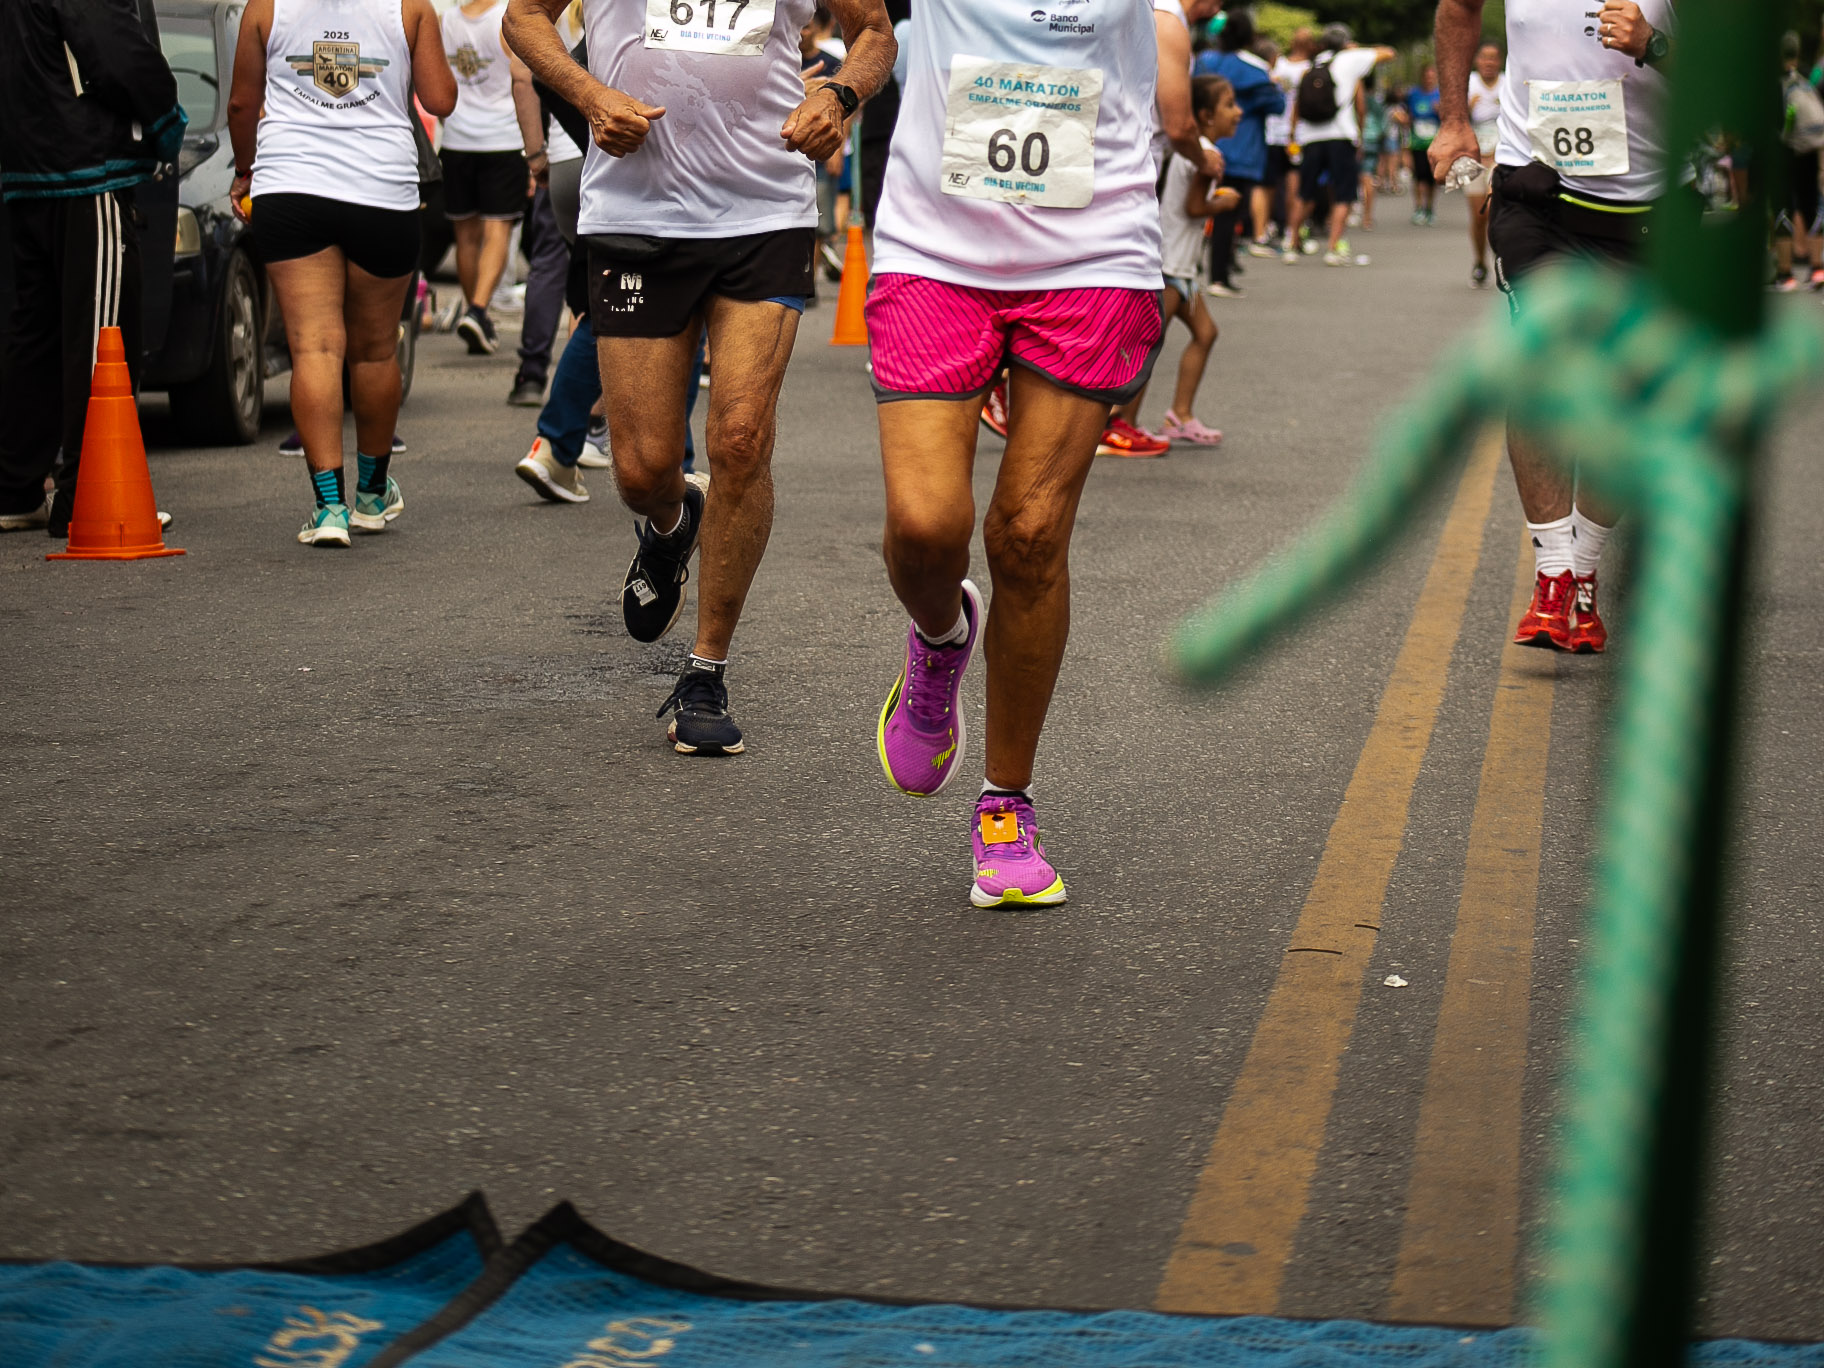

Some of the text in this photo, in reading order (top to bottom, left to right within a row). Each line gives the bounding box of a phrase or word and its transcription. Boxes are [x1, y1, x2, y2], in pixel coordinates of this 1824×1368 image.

[1050, 14, 1079, 23] Banco
[323, 30, 350, 40] 2025
[650, 28, 669, 39] NEJ
[1049, 23, 1095, 35] Municipal
[706, 33, 731, 42] VECINO
[318, 45, 354, 54] ARGENTINA
[323, 72, 350, 88] 40
[974, 76, 1080, 97] 40 MARATON
[293, 86, 335, 110] EMPALME
[968, 93, 1082, 112] EMPALME GRANEROS
[1540, 92, 1607, 102] 40 MARATON
[1569, 104, 1611, 113] GRANEROS
[1553, 127, 1595, 157] 68
[987, 128, 1050, 177] 60
[948, 173, 970, 185] NEJ
[983, 176, 1046, 192] DIA DEL VECINO
